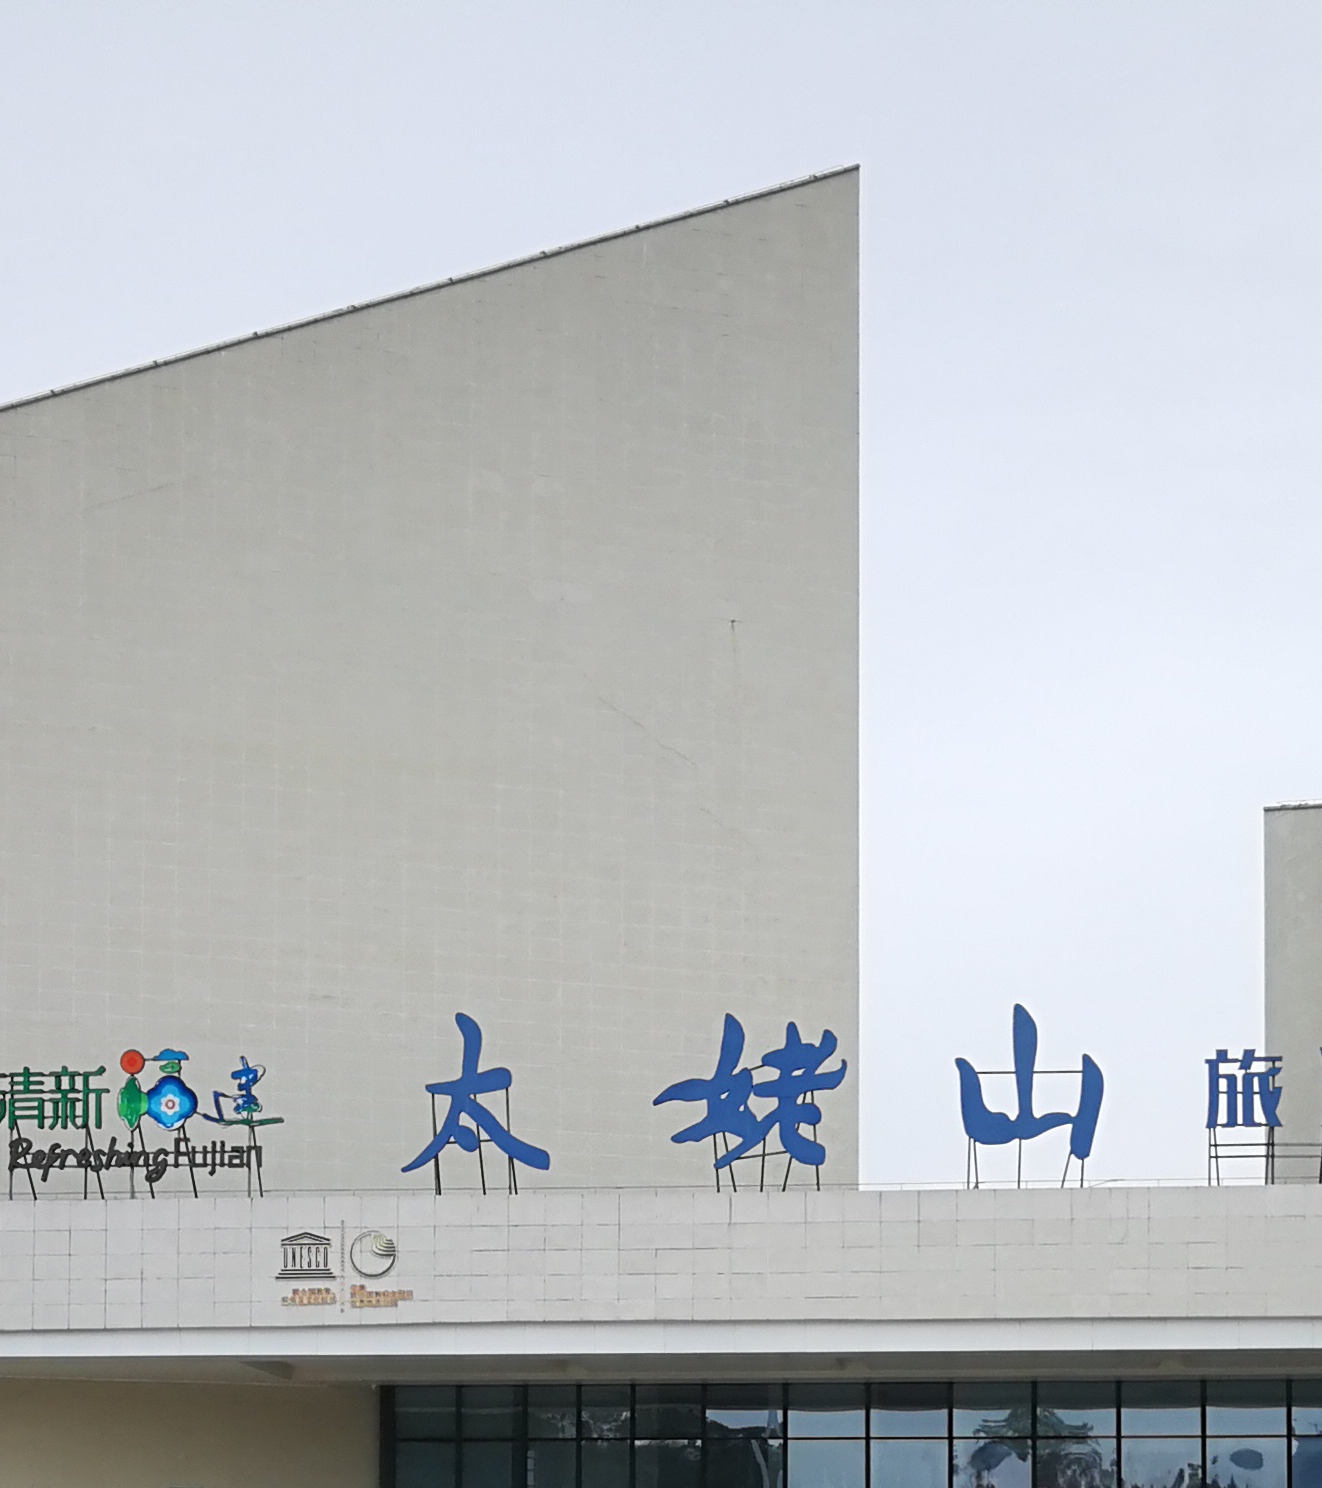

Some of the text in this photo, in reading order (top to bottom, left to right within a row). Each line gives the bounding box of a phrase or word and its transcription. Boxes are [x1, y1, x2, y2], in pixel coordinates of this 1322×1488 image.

[401, 1004, 1105, 1172] 太姥山
[8, 1136, 263, 1183] Refreshing Fujian
[283, 1246, 329, 1268] UNESCO
